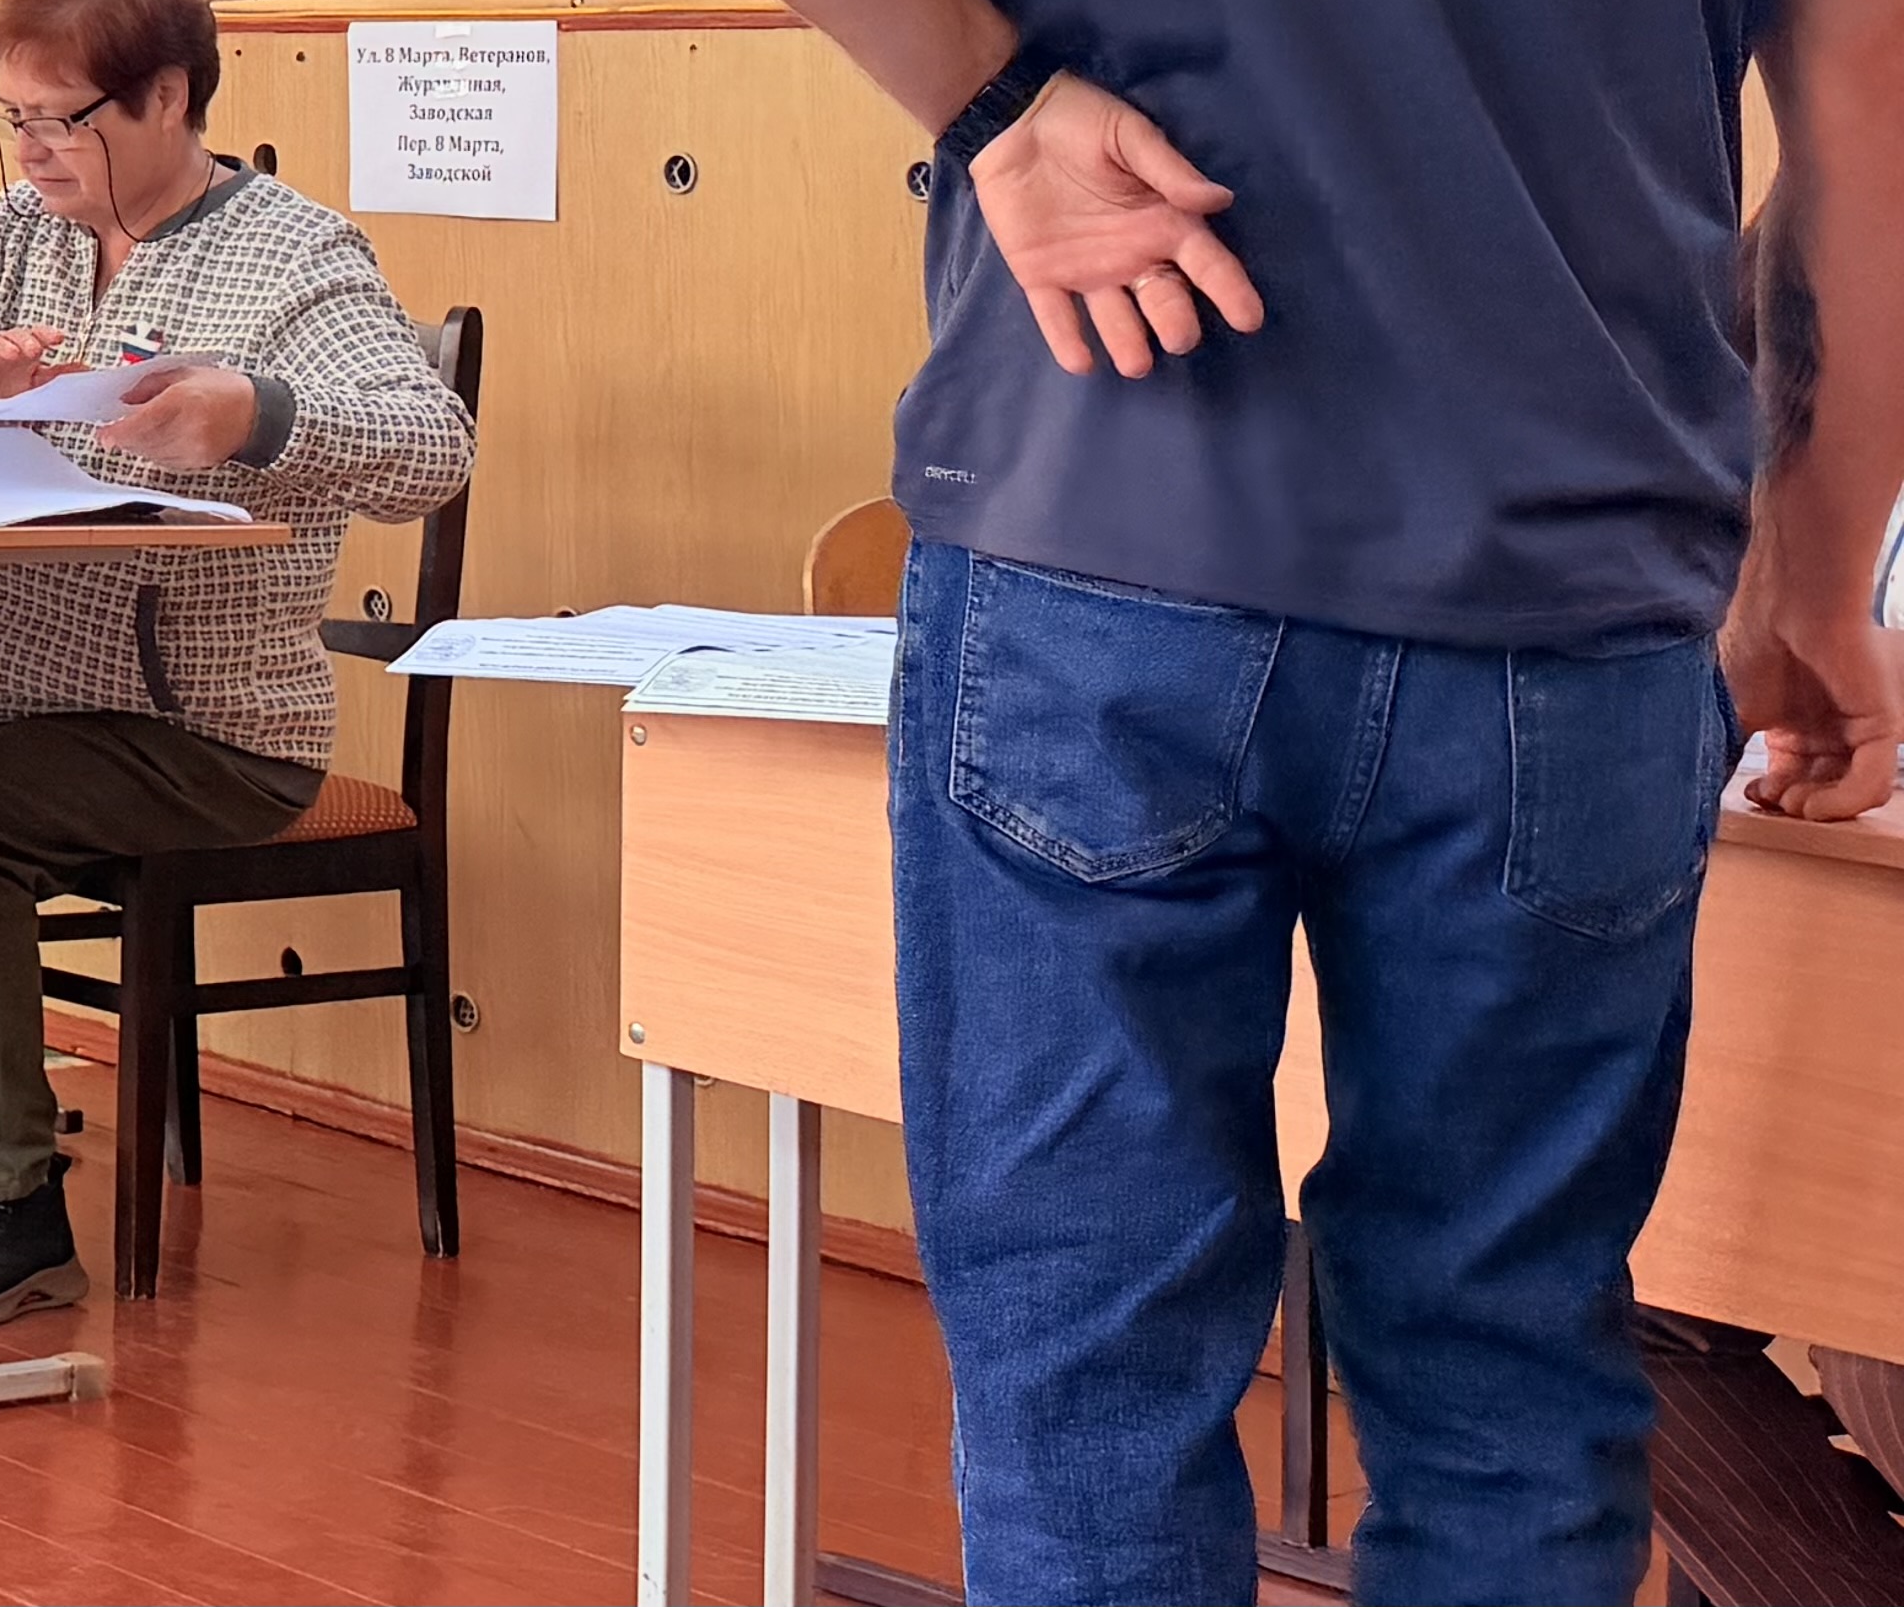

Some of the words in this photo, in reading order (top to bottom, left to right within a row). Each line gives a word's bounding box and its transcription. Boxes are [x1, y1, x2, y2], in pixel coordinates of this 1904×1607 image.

[357, 47, 381, 64] Ул.
[384, 47, 395, 63] 8
[458, 46, 551, 68] Ветеранов,
[408, 104, 493, 122] Заводская
[398, 135, 431, 156] Пер.
[435, 135, 445, 152] 8
[448, 135, 504, 156] Марта,
[407, 163, 492, 182] Заводской
